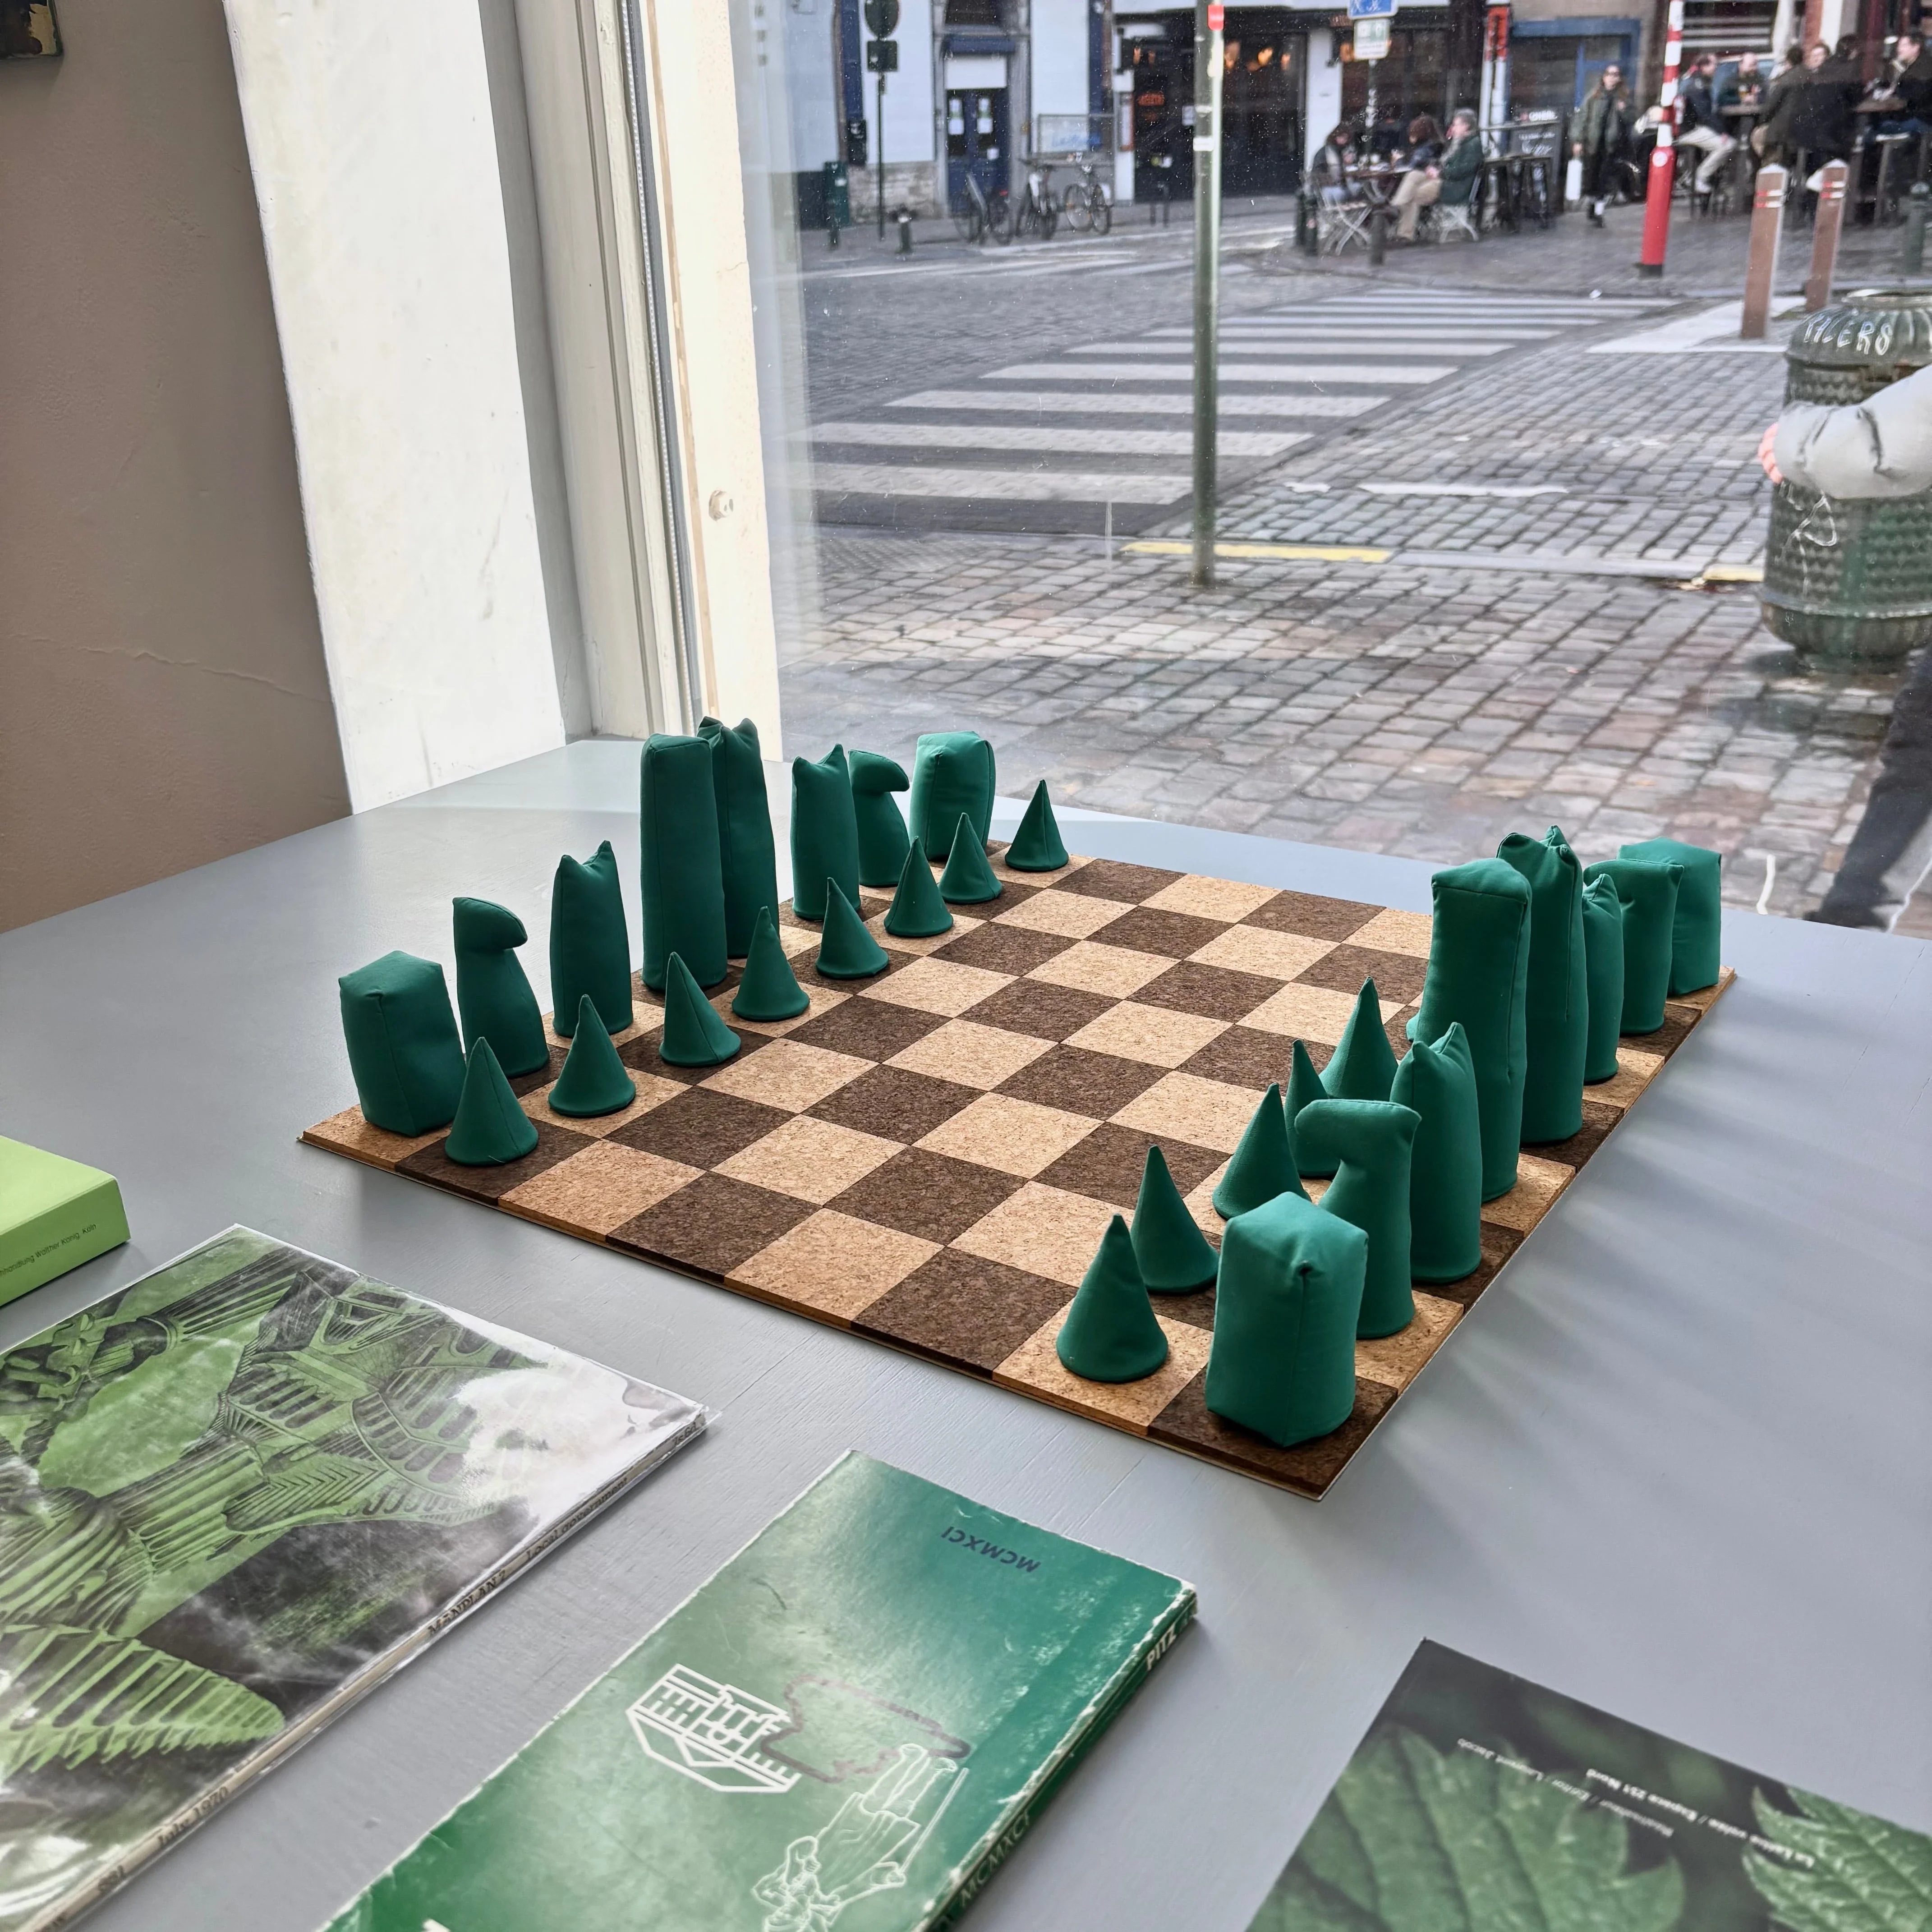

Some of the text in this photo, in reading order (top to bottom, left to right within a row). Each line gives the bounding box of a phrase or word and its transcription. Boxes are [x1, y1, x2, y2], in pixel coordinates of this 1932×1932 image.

[35, 1242, 60, 1258] Walther
[526, 1531, 559, 1560] Local
[561, 1477, 628, 1534] government
[941, 1526, 1041, 1573] MCMXCI
[1146, 1623, 1177, 1671] PITZ
[1457, 1738, 1495, 1759] Jacob
[1586, 1768, 1622, 1790] Nord
[1622, 1783, 1647, 1800] 251
